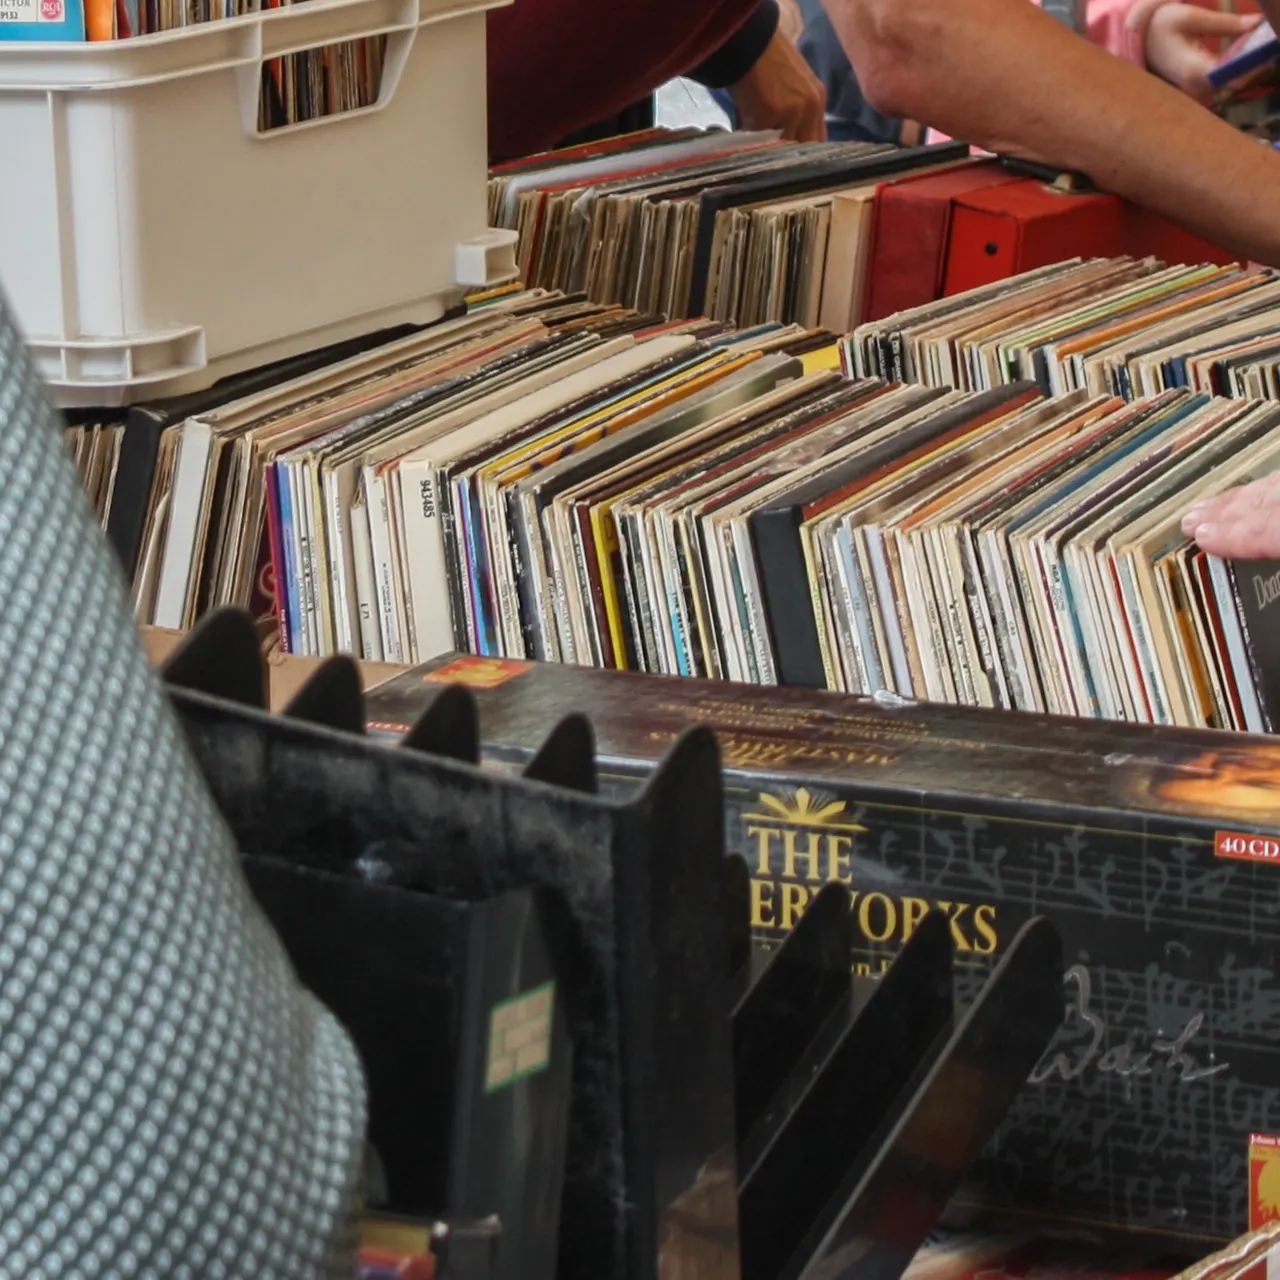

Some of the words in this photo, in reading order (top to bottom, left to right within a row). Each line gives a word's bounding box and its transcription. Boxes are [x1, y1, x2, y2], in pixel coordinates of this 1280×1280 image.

[420, 479, 435, 518] 943485
[747, 825, 854, 885] THE
[1220, 837, 1246, 854] 40
[1249, 839, 1280, 858] CD
[749, 877, 998, 955] ERORKS
